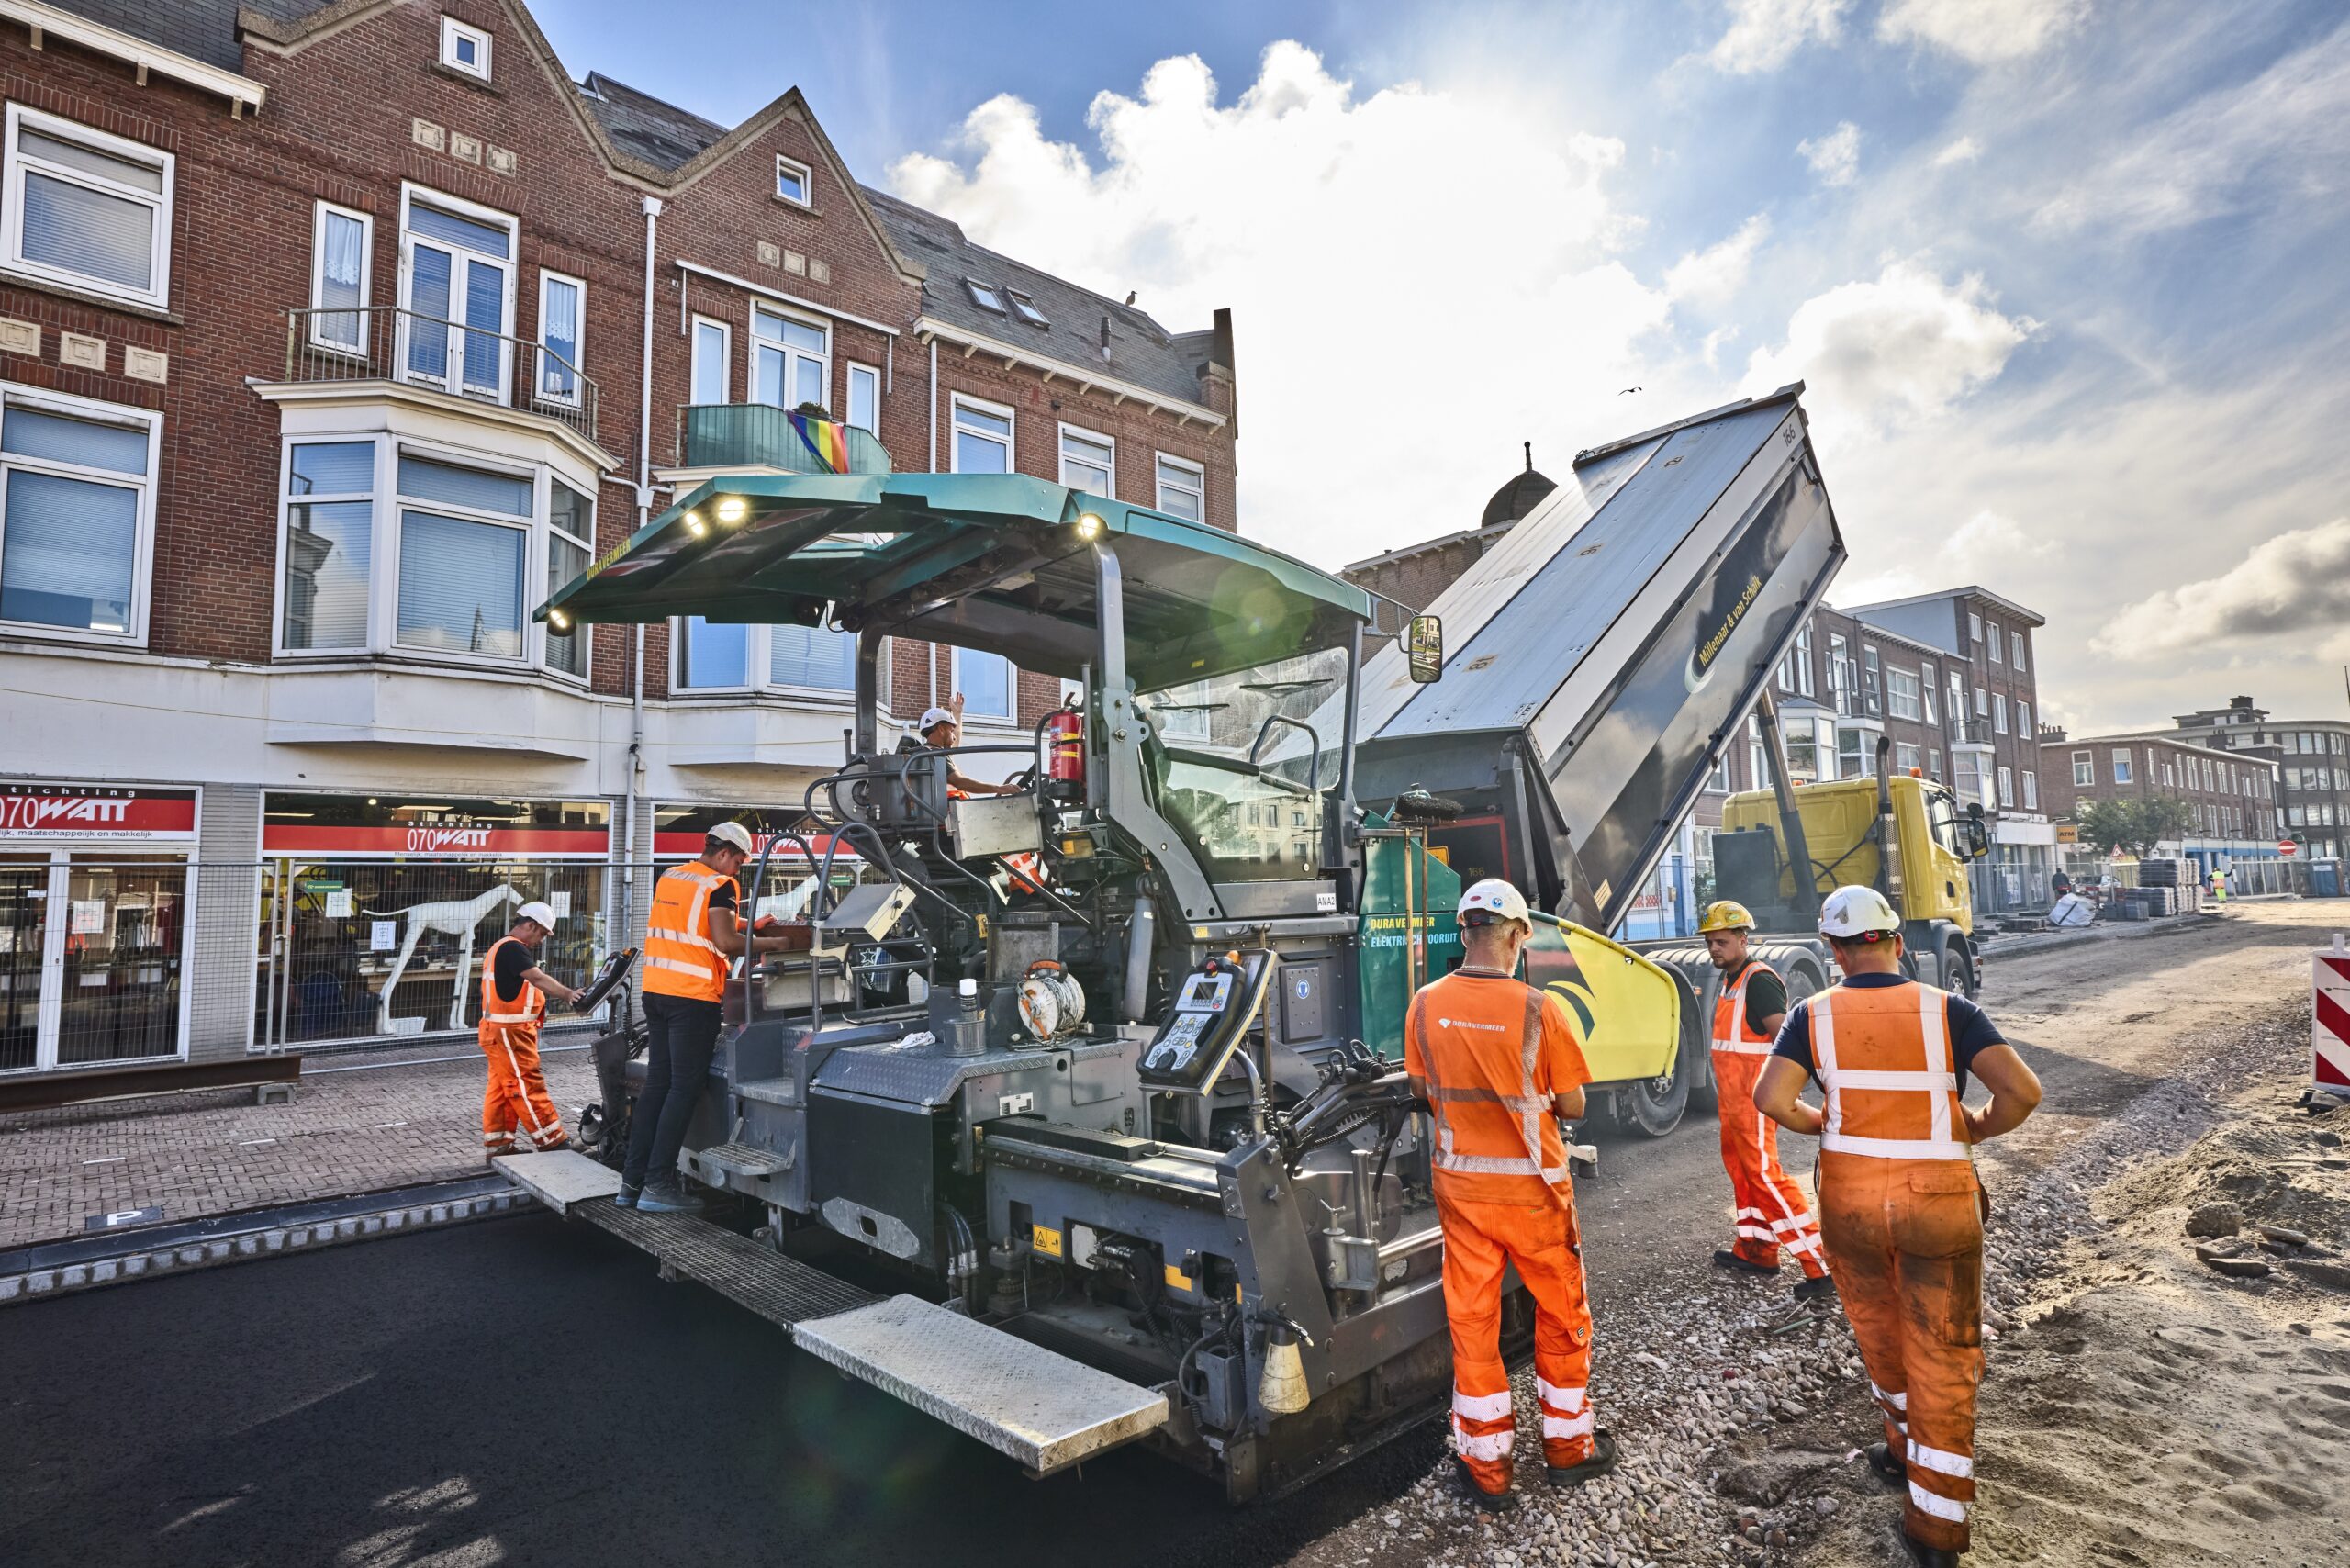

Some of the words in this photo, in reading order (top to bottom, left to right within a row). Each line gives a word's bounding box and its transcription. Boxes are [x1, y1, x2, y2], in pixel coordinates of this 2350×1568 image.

[1783, 423, 1796, 447] 166
[1698, 622, 1729, 667] Millenaar
[1726, 613, 1735, 628] &
[1732, 600, 1746, 620] van
[1741, 574, 1762, 606] Schalk
[408, 821, 493, 830] Stichting
[17, 829, 95, 838] maatschappelijk
[111, 831, 152, 839] makkelijk
[407, 829, 492, 851] 070WATT
[1468, 867, 1485, 878] 166
[1317, 896, 1335, 906] AMA2
[1371, 935, 1422, 948] ELEKTRICH
[1426, 933, 1458, 945] OORUIT
